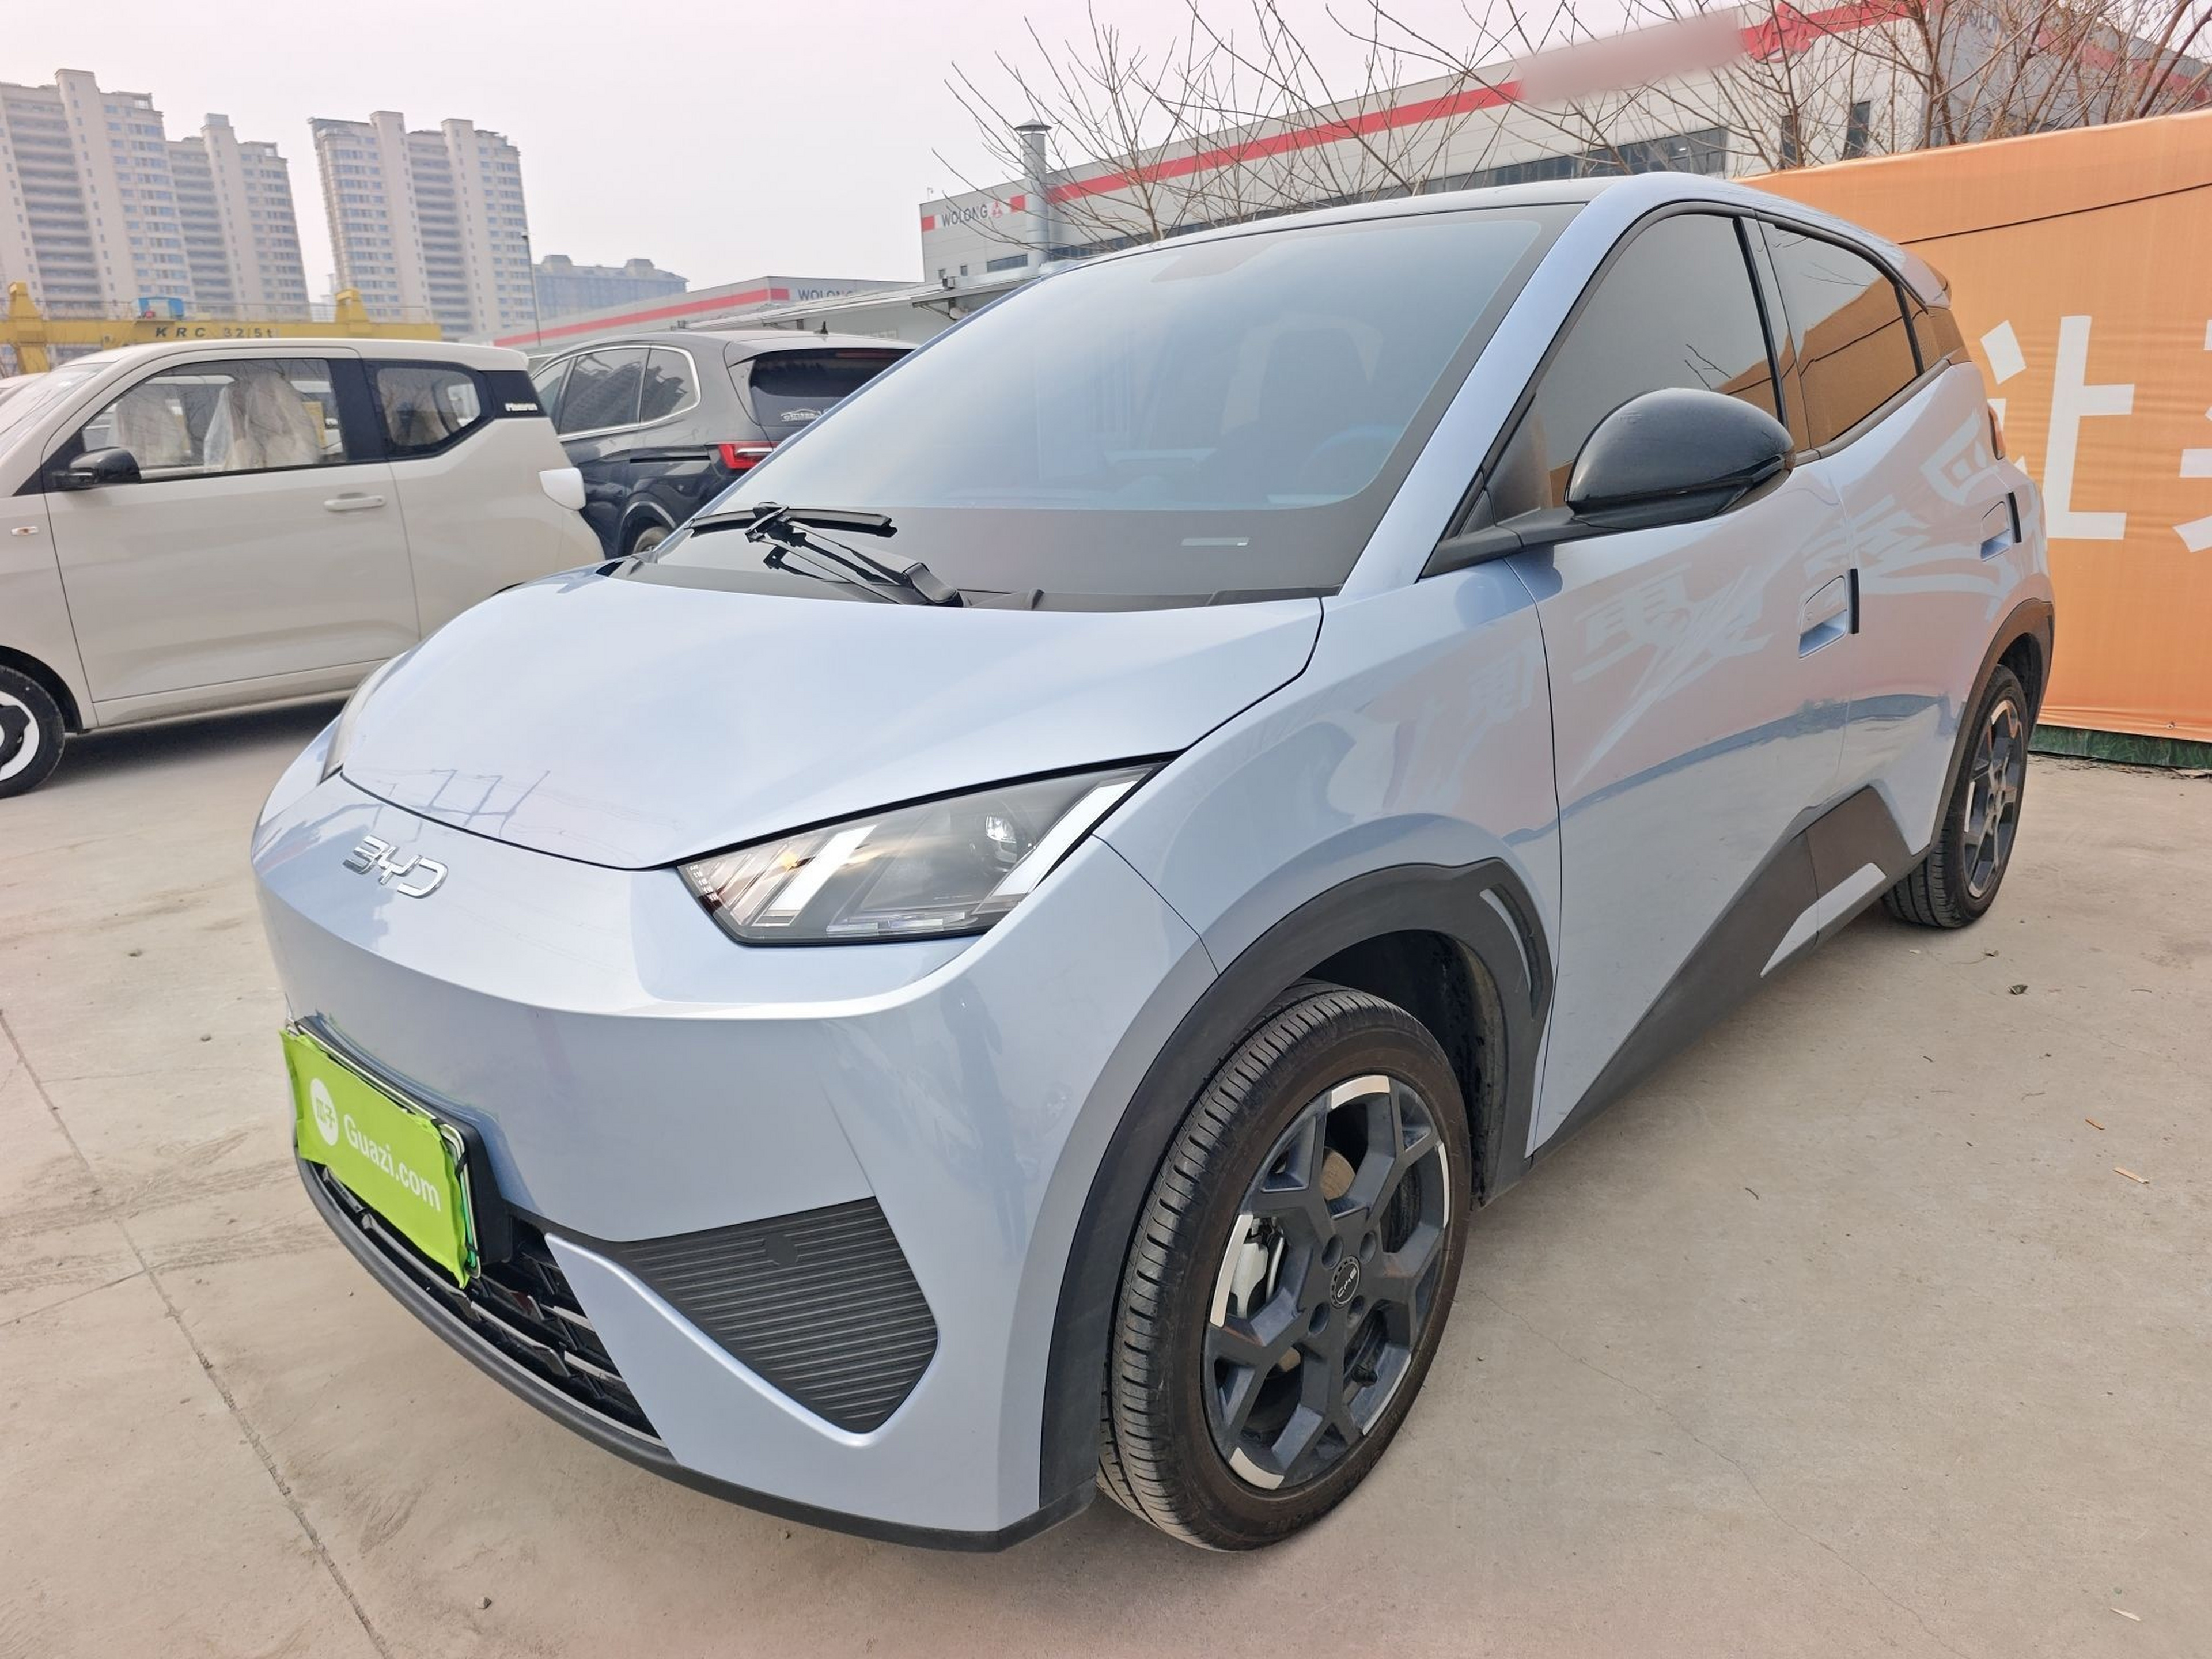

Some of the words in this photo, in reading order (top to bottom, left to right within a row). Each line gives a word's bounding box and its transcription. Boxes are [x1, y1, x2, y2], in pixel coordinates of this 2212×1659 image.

[942, 204, 987, 227] WOLONG
[155, 327, 206, 338] KRC
[343, 835, 449, 899] BYD
[344, 1114, 441, 1212] Guazi.com
